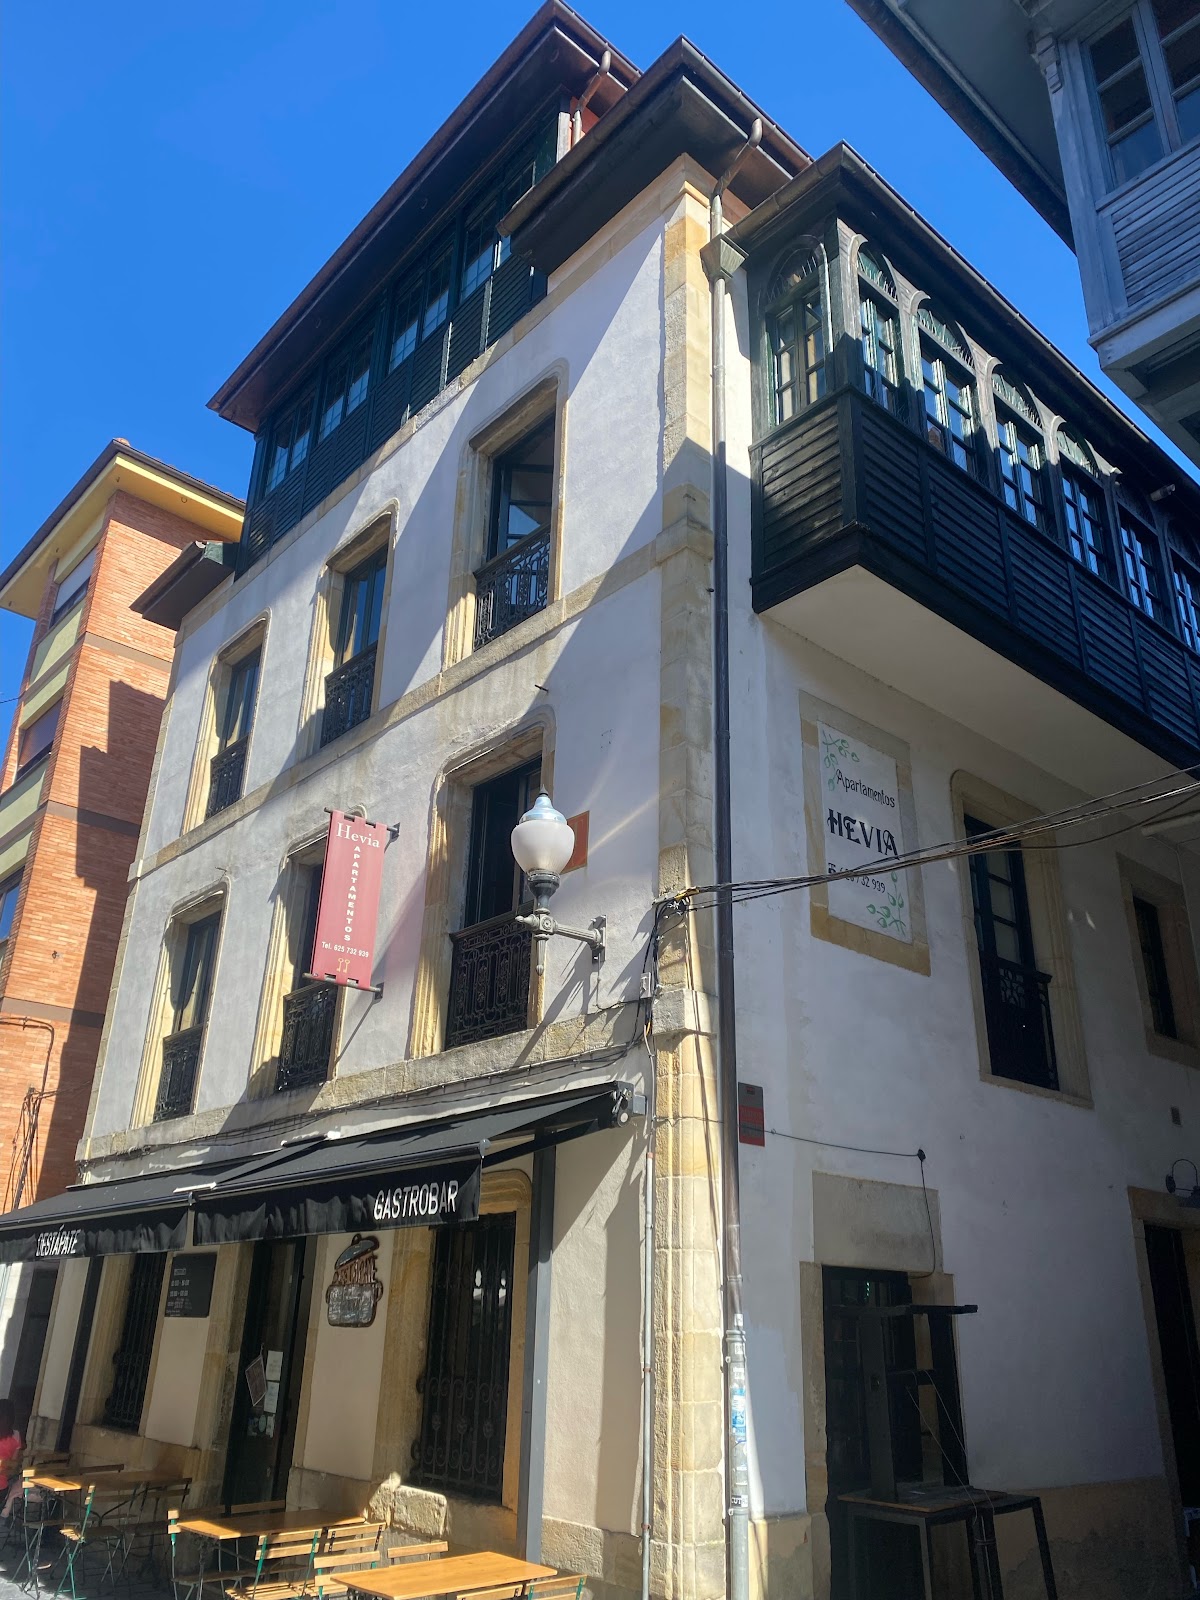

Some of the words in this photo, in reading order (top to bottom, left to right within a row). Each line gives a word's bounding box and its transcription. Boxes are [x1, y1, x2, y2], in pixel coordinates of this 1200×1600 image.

[836, 768, 896, 808] Apartamentos
[336, 822, 380, 848] Hevia
[827, 808, 900, 861] HEVIA
[344, 846, 361, 941] APARTAMENTOS
[872, 878, 886, 894] 939
[321, 941, 332, 950] Tel.
[334, 944, 345, 953] 625
[346, 946, 357, 956] 732
[358, 949, 369, 958] 939
[373, 1180, 459, 1220] GASTROBAR
[36, 1224, 82, 1257] DESTÁPATE
